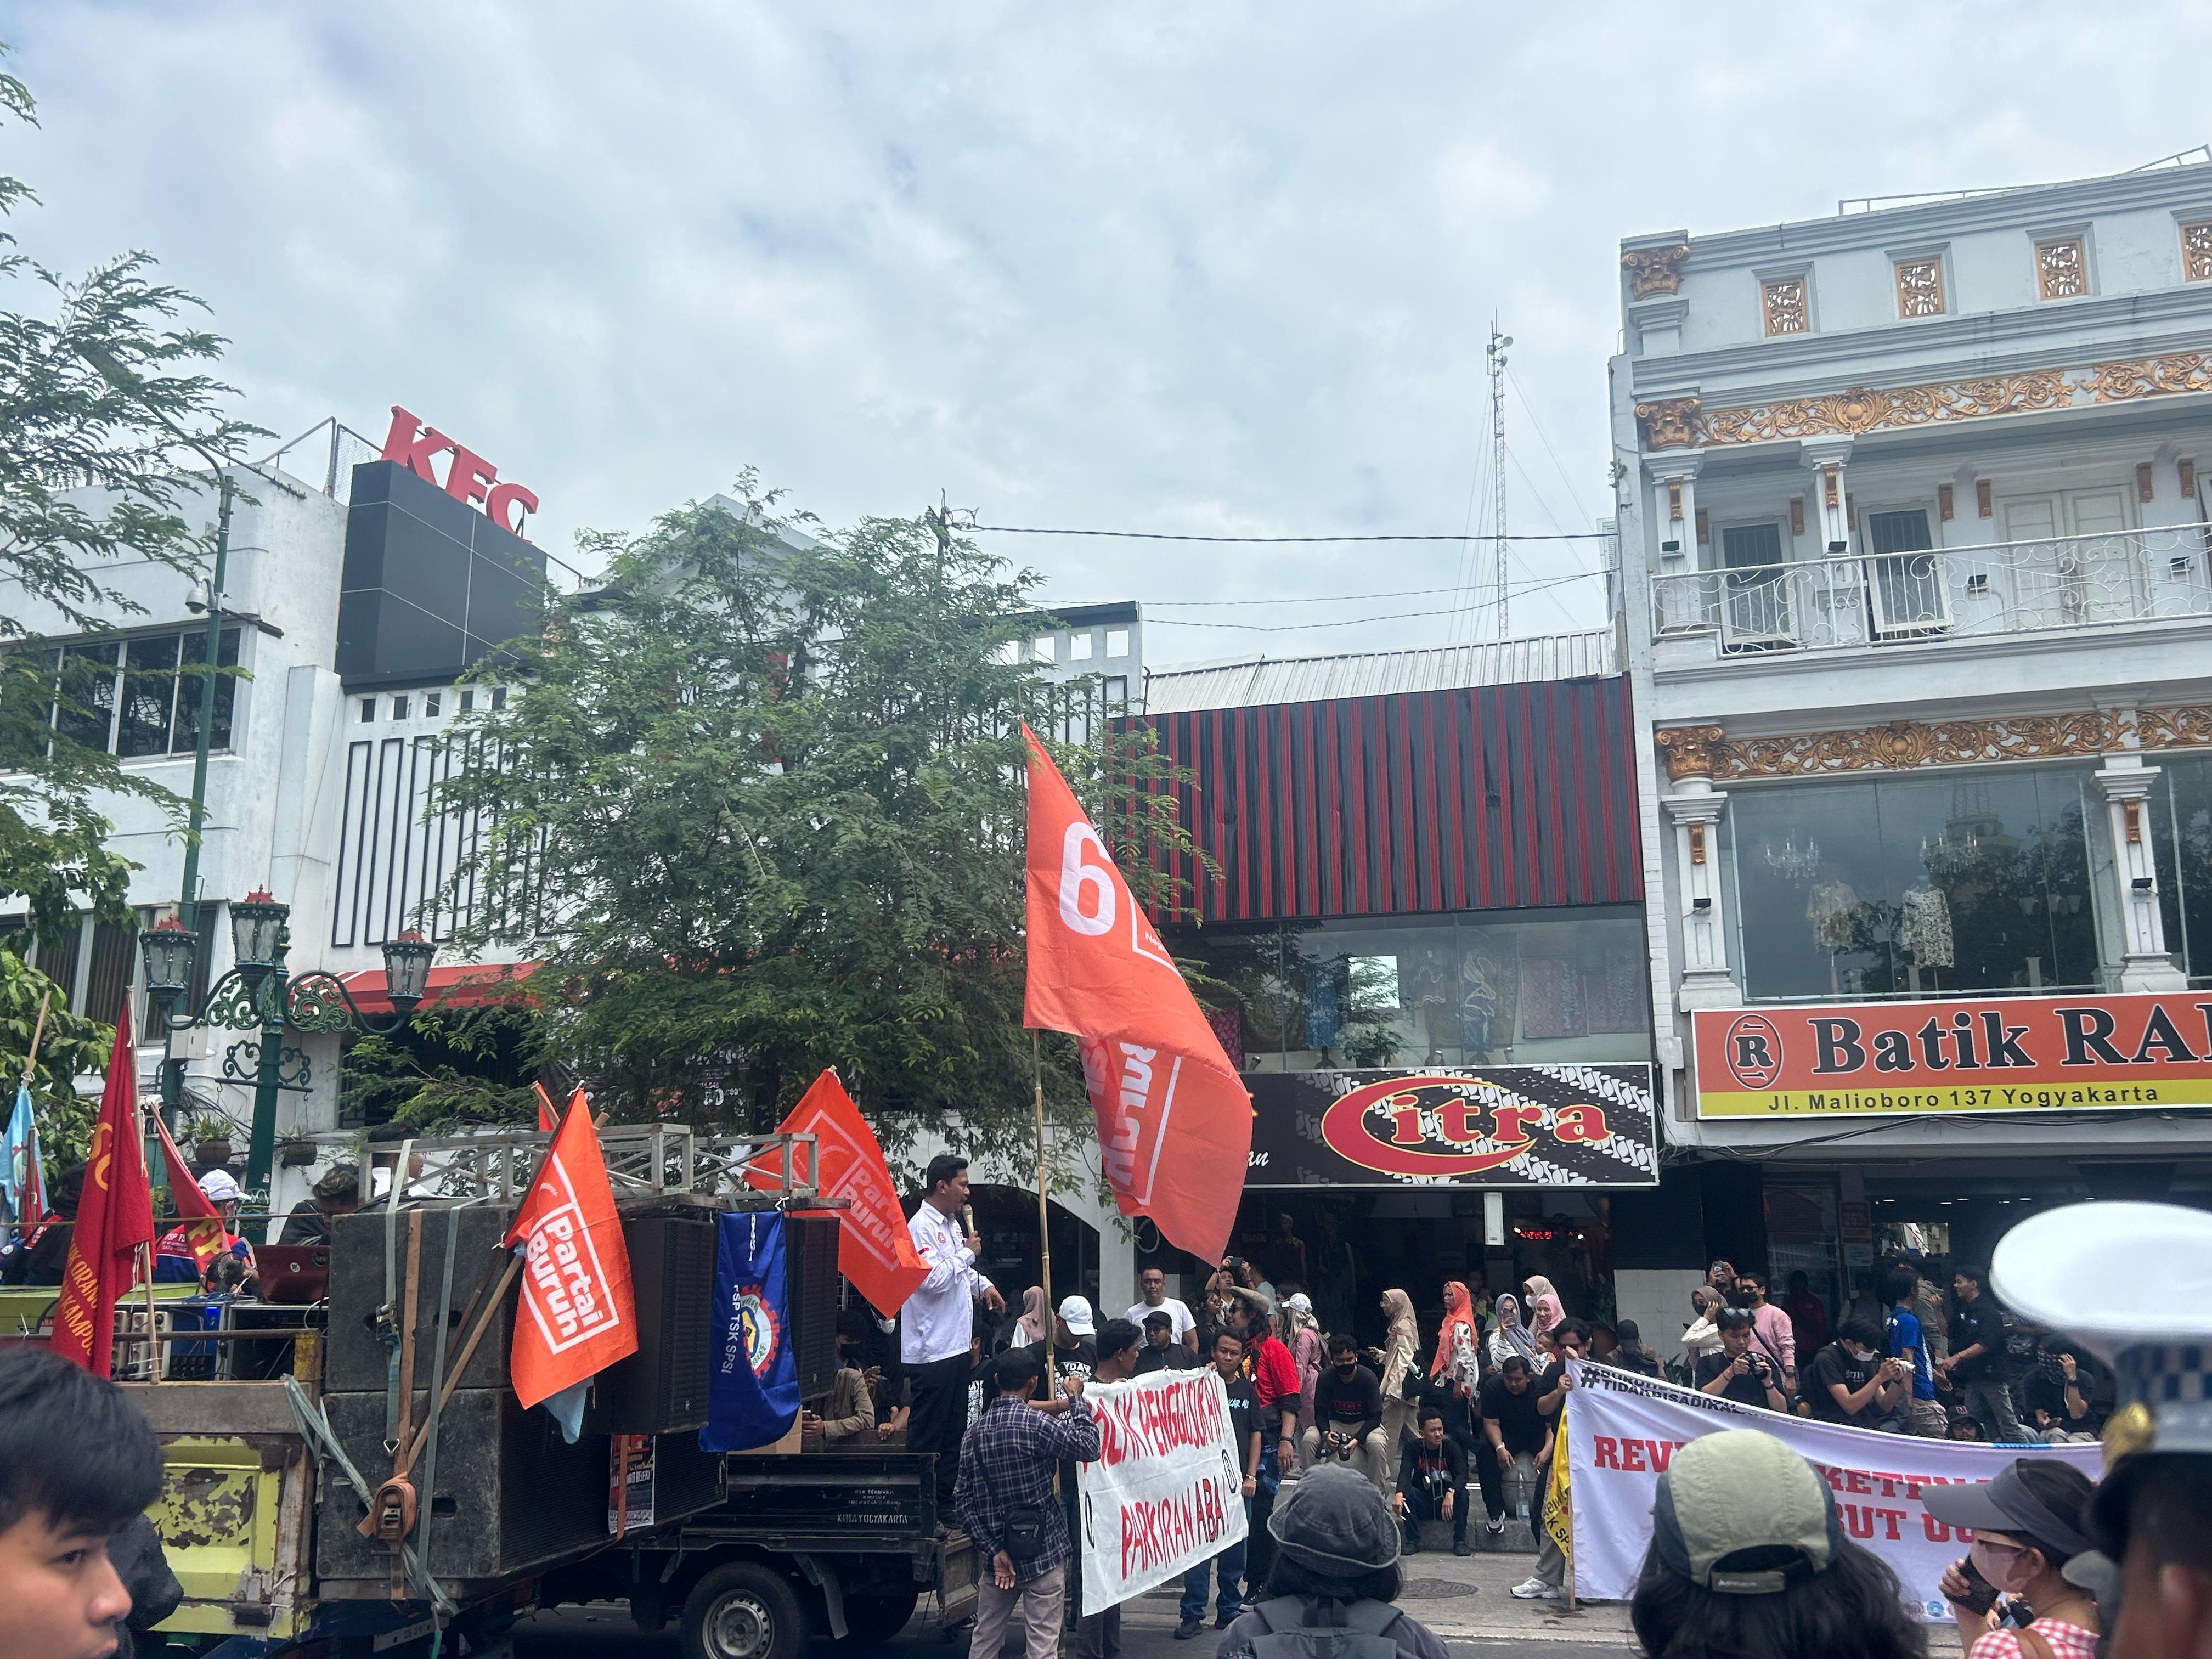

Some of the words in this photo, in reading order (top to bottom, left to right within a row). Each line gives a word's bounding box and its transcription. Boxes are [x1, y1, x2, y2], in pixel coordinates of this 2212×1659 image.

[381, 405, 539, 544] KFC
[1059, 821, 1116, 936] 6
[1807, 1012, 2037, 1074] Batik
[2053, 1003, 2212, 1066] RA
[1321, 1076, 1612, 1177] Citra
[1769, 1096, 1798, 1110] Jl.
[1809, 1093, 1939, 1110] Malioboro
[1949, 1090, 1991, 1105] 137
[2002, 1086, 2158, 1107] Yogyakarta
[527, 1231, 578, 1338] Buruh
[544, 1216, 604, 1327] Partai
[721, 1344, 736, 1374] SPSI
[727, 1313, 740, 1342] TSK
[1593, 1435, 1688, 1473] REV
[1121, 1486, 1195, 1580] PARKIRAN
